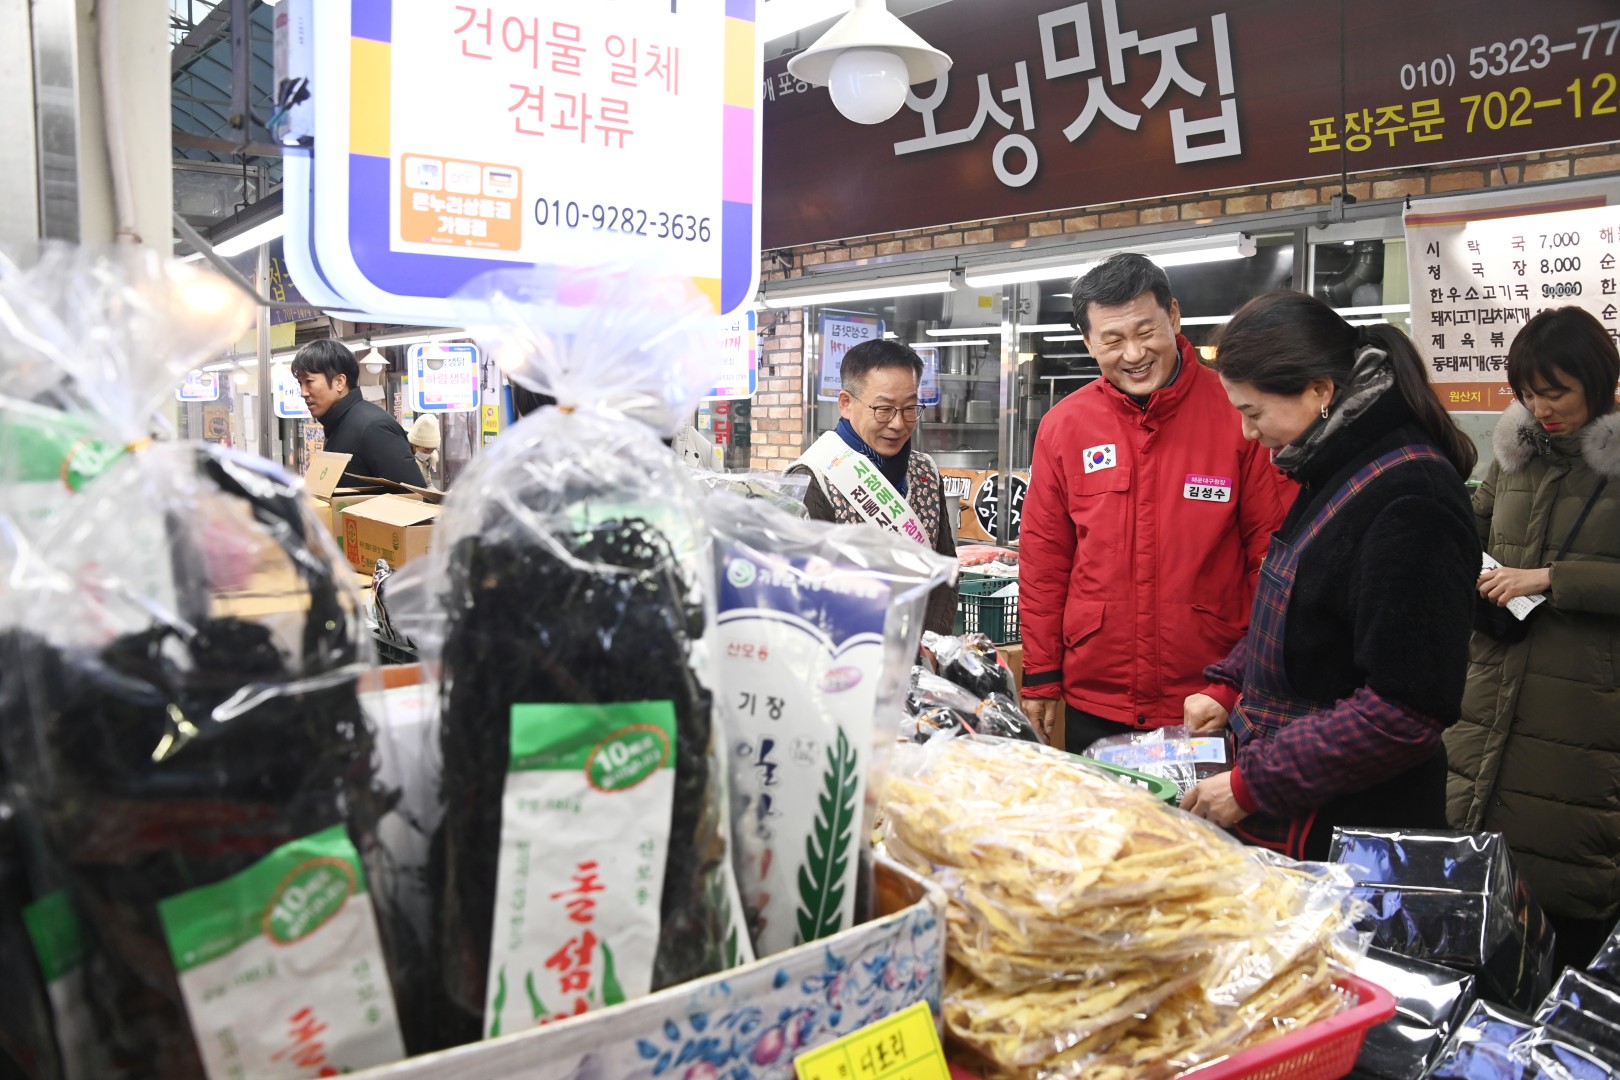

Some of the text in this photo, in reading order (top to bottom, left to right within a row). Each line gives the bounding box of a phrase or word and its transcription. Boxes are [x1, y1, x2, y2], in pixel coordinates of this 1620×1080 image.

[453, 5, 680, 96] 건어물 일체
[1401, 54, 1456, 90] 010)
[507, 82, 635, 149] 견과류
[1308, 98, 1446, 153] 포장주문
[534, 198, 711, 243] 010-9282-3636
[1539, 231, 1580, 249] 7,000
[1540, 256, 1581, 274] 8,000
[1431, 307, 1531, 327] 돼지고기김치찌개
[1449, 391, 1481, 403] 원산지
[1189, 486, 1226, 500] 김성수
[738, 692, 784, 720] 기장
